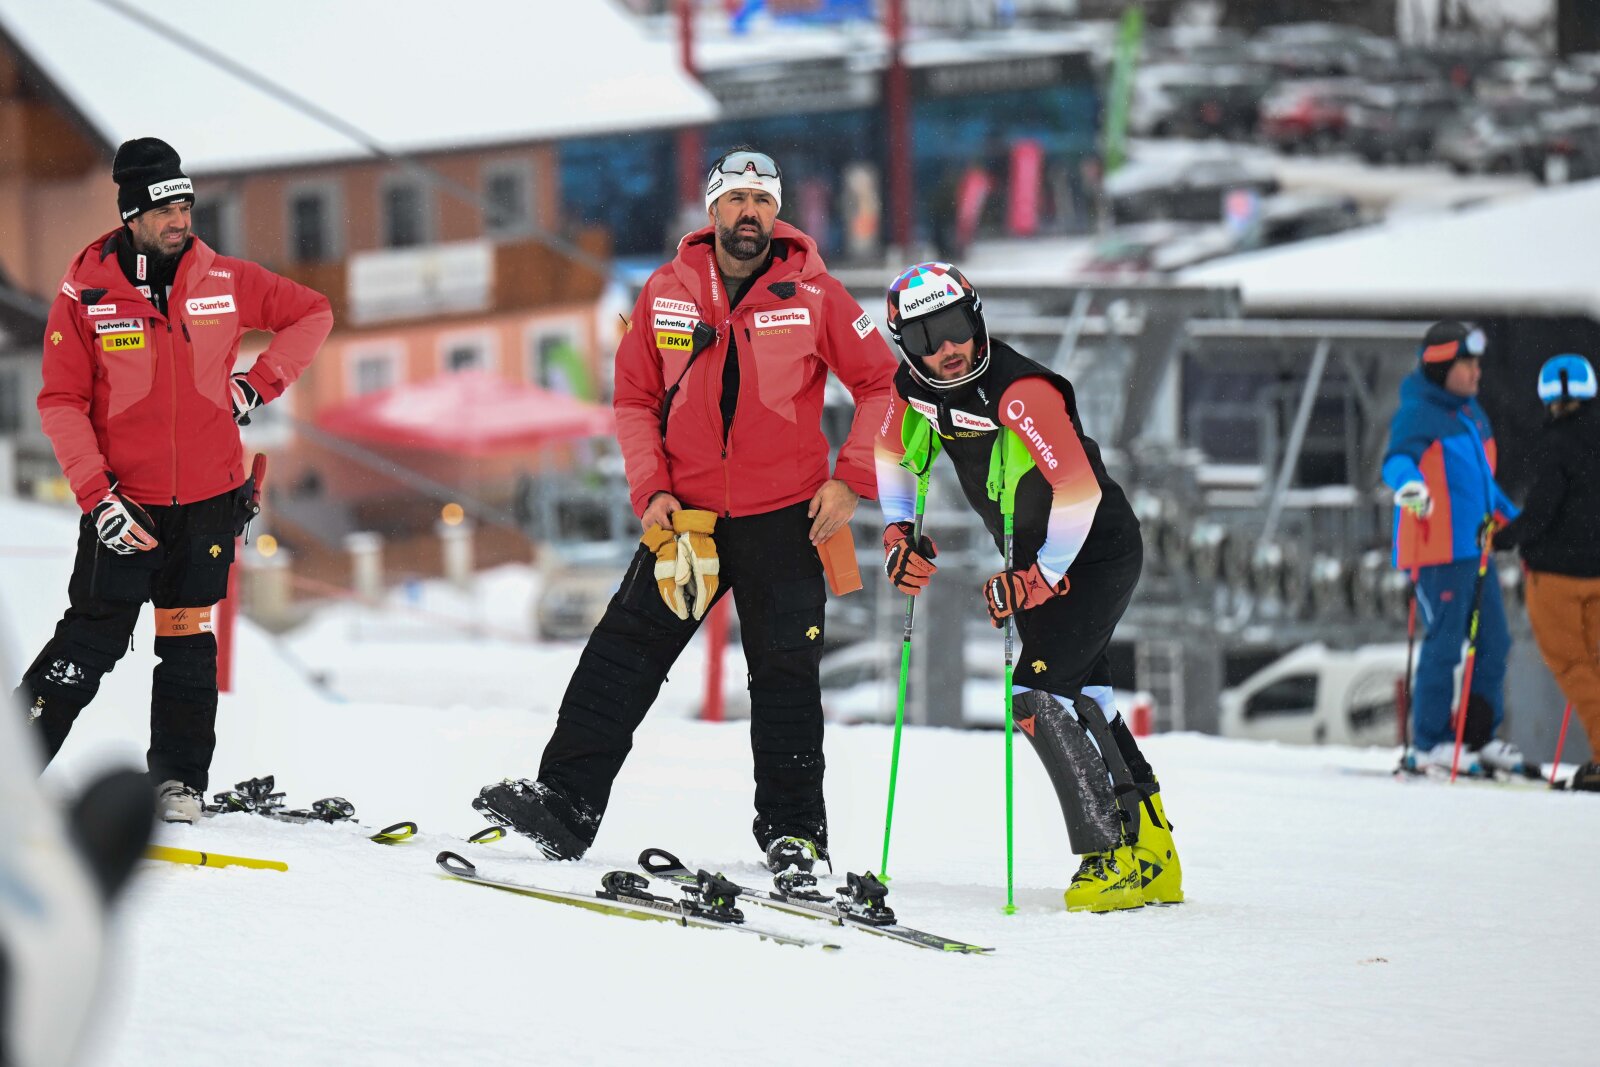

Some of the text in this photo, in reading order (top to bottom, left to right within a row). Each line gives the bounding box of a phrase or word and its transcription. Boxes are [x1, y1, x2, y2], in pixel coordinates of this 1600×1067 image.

[163, 181, 191, 193] Sunrise
[711, 279, 719, 301] team
[199, 300, 230, 310] Sunrise
[904, 290, 945, 313] helvetia
[771, 312, 805, 322] Sunrise
[97, 321, 131, 331] helvetia
[655, 318, 686, 328] helvetia
[757, 328, 792, 337] DESCENTE
[115, 336, 140, 347] BKW
[667, 336, 690, 346] BKW
[963, 416, 992, 428] Sunrise
[1019, 416, 1058, 470] Sunrise
